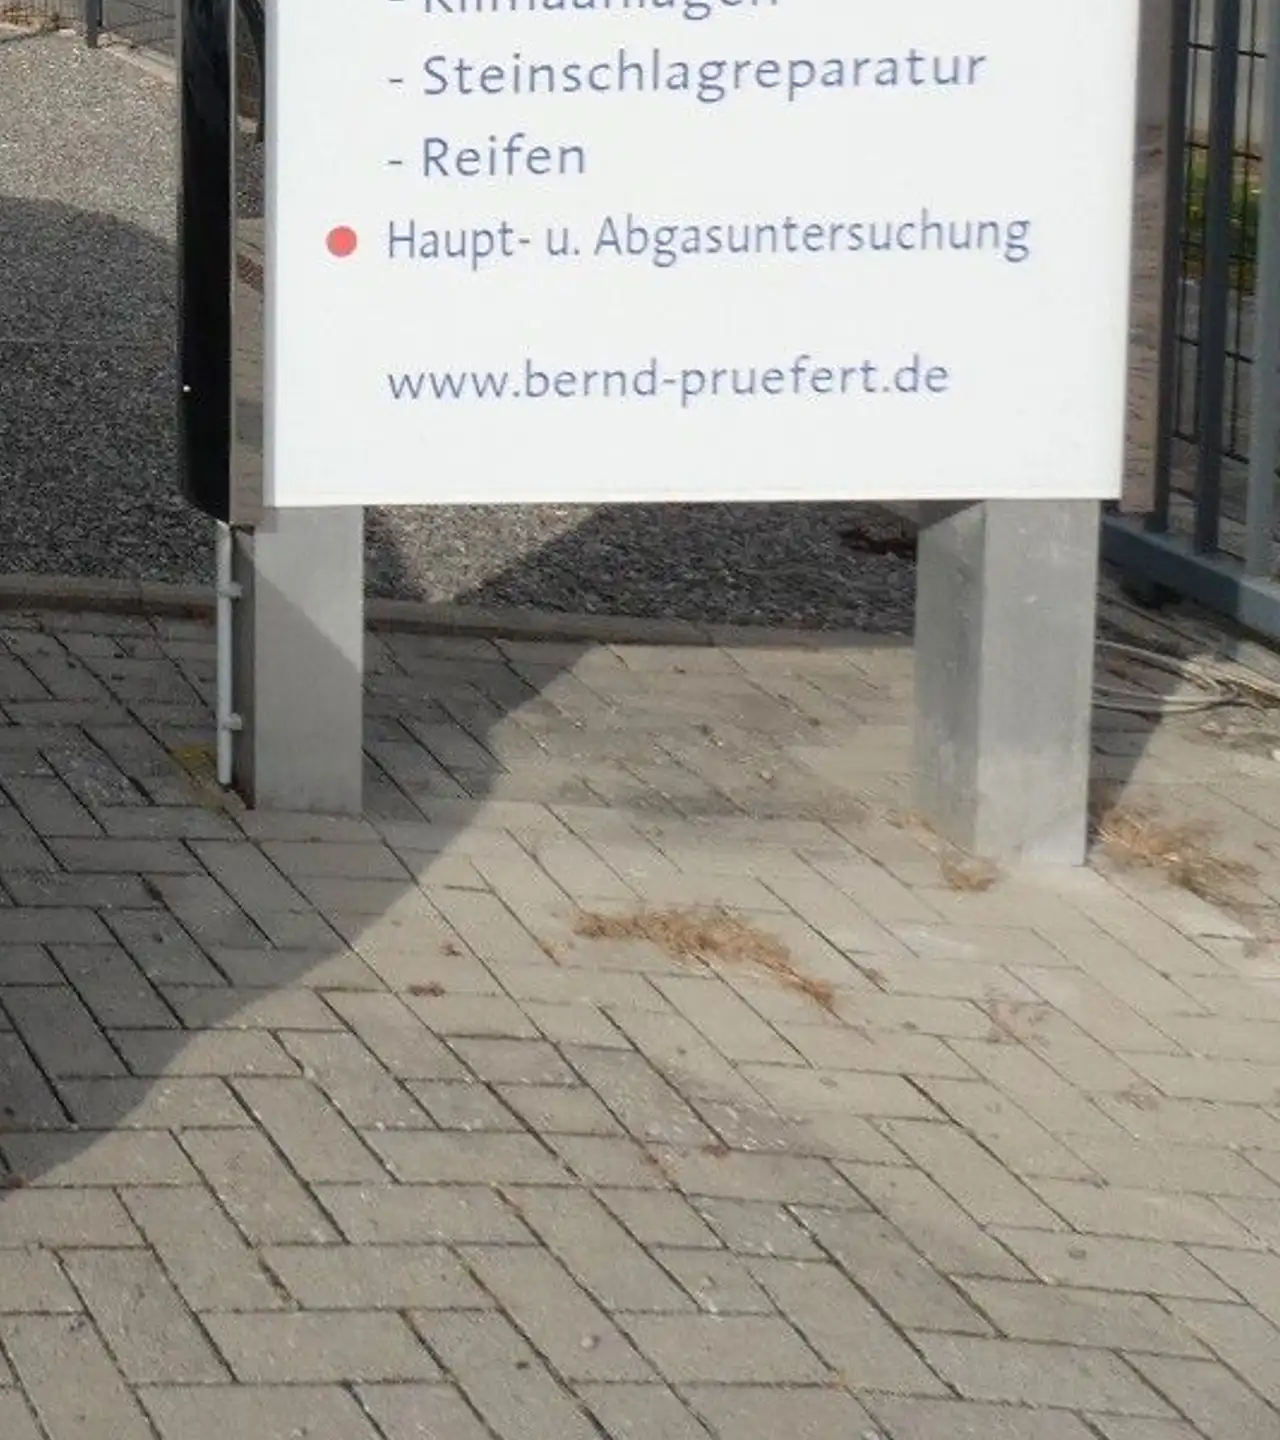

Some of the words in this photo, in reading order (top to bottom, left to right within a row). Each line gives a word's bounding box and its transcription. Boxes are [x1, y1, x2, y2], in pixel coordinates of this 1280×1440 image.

[422, 47, 987, 105] Steinschlagreparatur
[422, 131, 585, 178] Reifen
[388, 217, 531, 272] Haupt-
[546, 227, 581, 257] u.
[593, 207, 1031, 269] Abgasuntersuchung
[386, 353, 950, 409] www.bernd-pruefert.de
